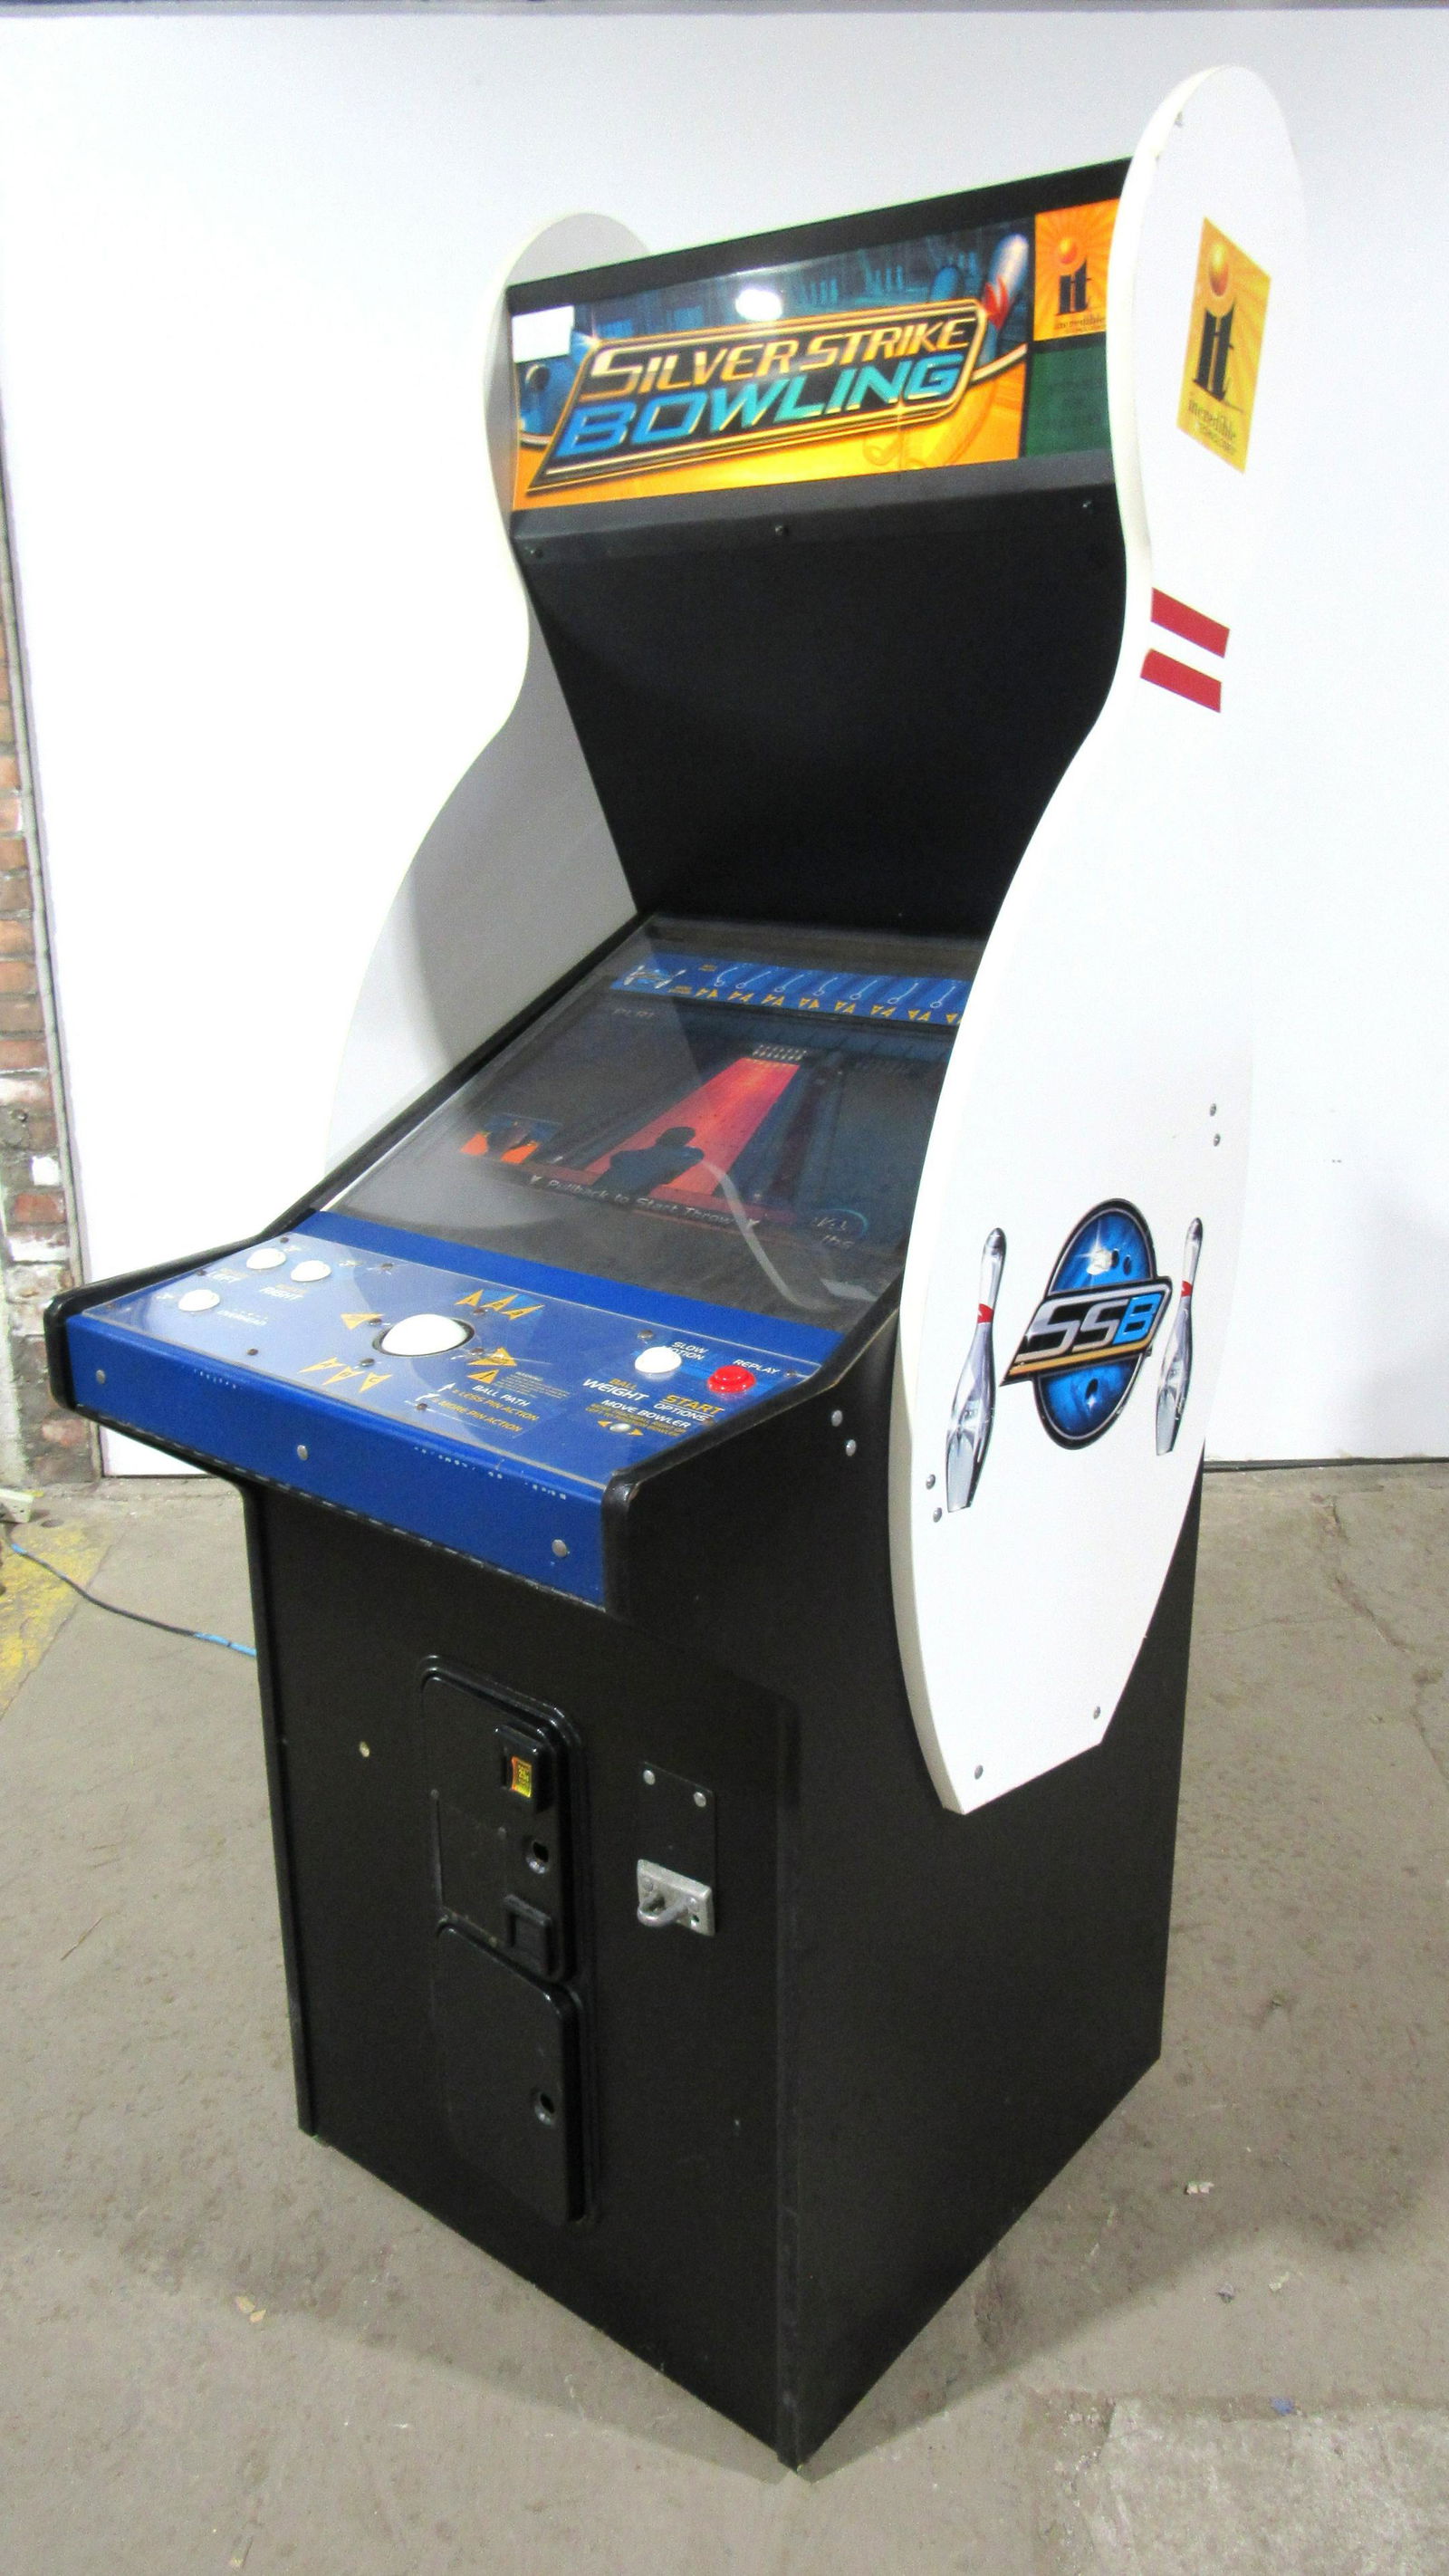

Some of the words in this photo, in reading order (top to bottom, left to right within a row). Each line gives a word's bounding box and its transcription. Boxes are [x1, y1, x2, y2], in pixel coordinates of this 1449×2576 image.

[580, 339, 801, 401] SILVER
[802, 317, 978, 367] STRIKE
[554, 354, 967, 457] BOWLING
[547, 1179, 609, 1202] Pullback
[614, 1193, 630, 1205] to
[637, 1197, 679, 1213] Start
[1014, 1290, 1165, 1362] SSB
[671, 1341, 709, 1354] SLOW
[732, 1359, 782, 1375] REPLAY
[581, 1379, 650, 1401] WEIGHT
[608, 1378, 638, 1390] BALL
[472, 1385, 500, 1398] BALL
[500, 1394, 532, 1408] PATH
[663, 1394, 725, 1416] START
[500, 1406, 541, 1421] ACTION
[601, 1399, 638, 1415] MOVE
[637, 1409, 692, 1429] BOWLER
[653, 1403, 710, 1422] OPTIONS
[485, 1417, 523, 1433] ACTION
